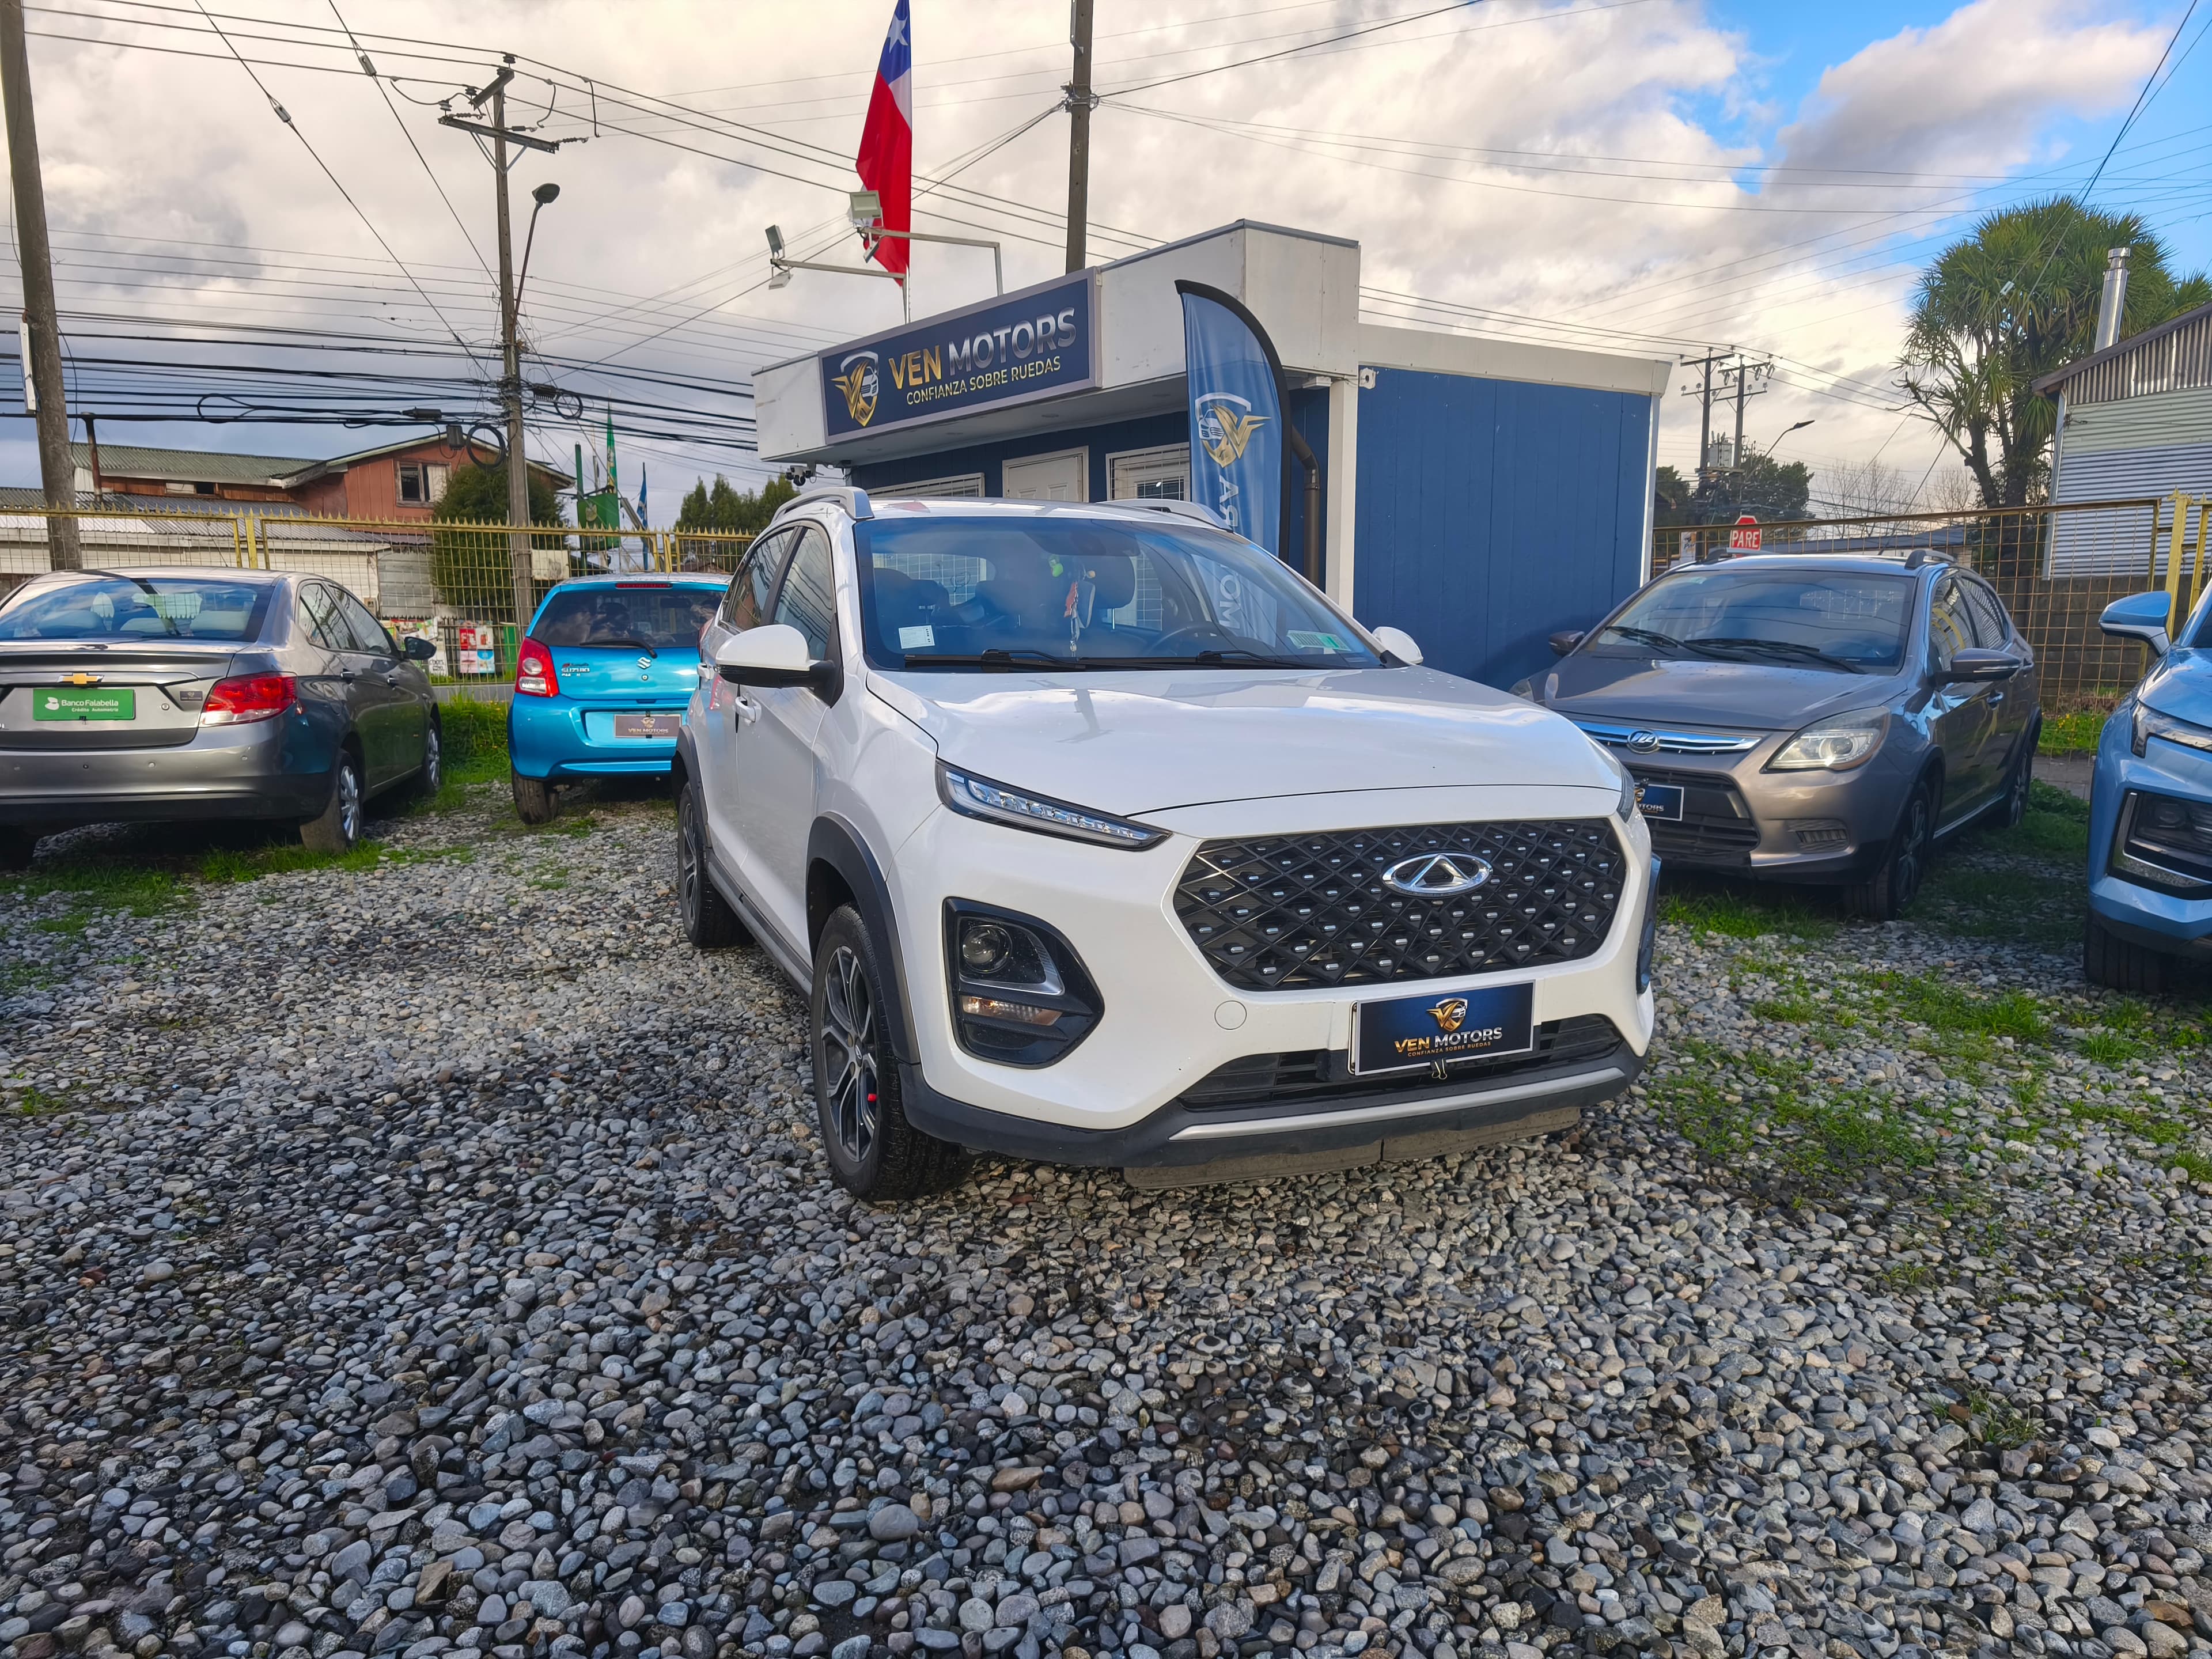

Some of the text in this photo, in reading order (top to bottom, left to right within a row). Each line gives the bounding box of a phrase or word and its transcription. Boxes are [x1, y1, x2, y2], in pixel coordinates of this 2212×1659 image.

[888, 307, 1077, 389] VEN MOTORS
[906, 355, 1061, 405] CONFIANZA SOBRE RUEDAS
[1732, 529, 1760, 549] PARE
[1395, 1027, 1503, 1054] VEN MOTORS
[1408, 1041, 1491, 1057] CONFIANZA SOBRE RUEDAS
